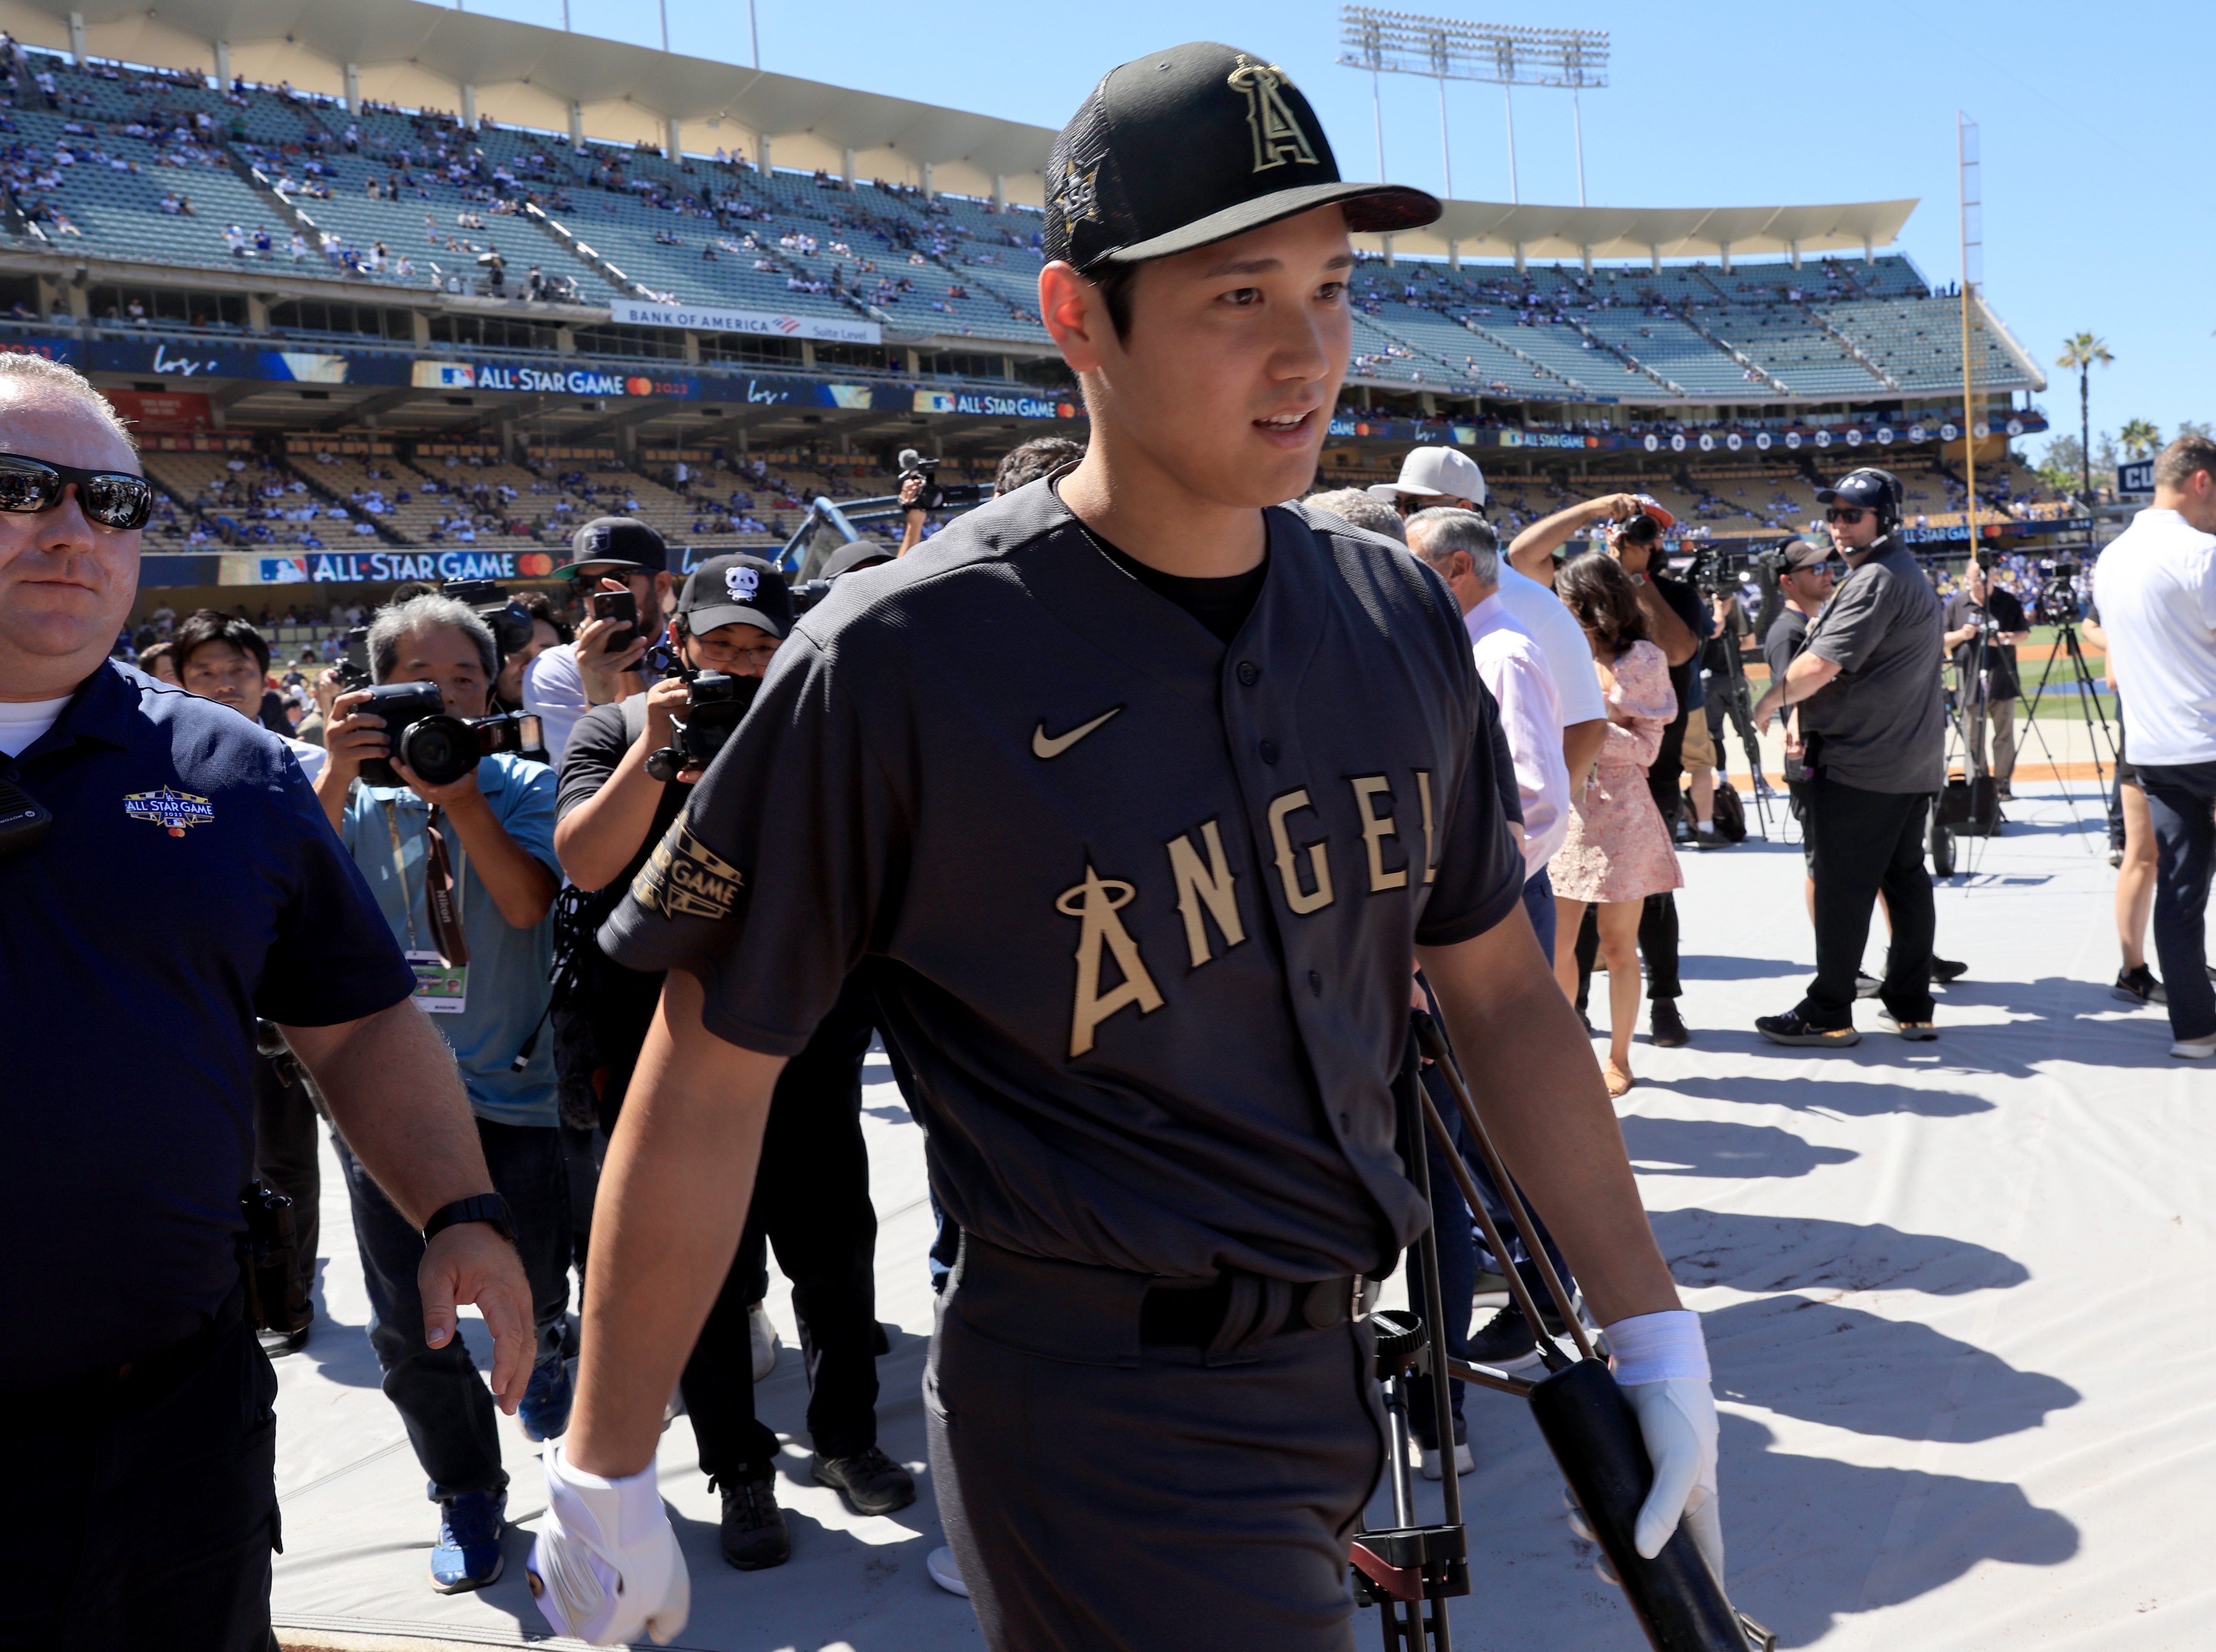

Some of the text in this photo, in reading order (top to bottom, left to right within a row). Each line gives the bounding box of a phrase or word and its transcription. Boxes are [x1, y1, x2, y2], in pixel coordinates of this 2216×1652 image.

[629, 310, 769, 331] BANK OF AMERICA
[567, 371, 624, 395] GAME
[1017, 398, 1056, 419] GAME
[1329, 419, 1356, 436] GAME
[1561, 434, 1586, 448] GAME
[437, 552, 516, 579] GAME
[180, 802, 213, 815] GAME
[671, 859, 739, 906] GAME
[436, 890, 452, 923] Nikon
